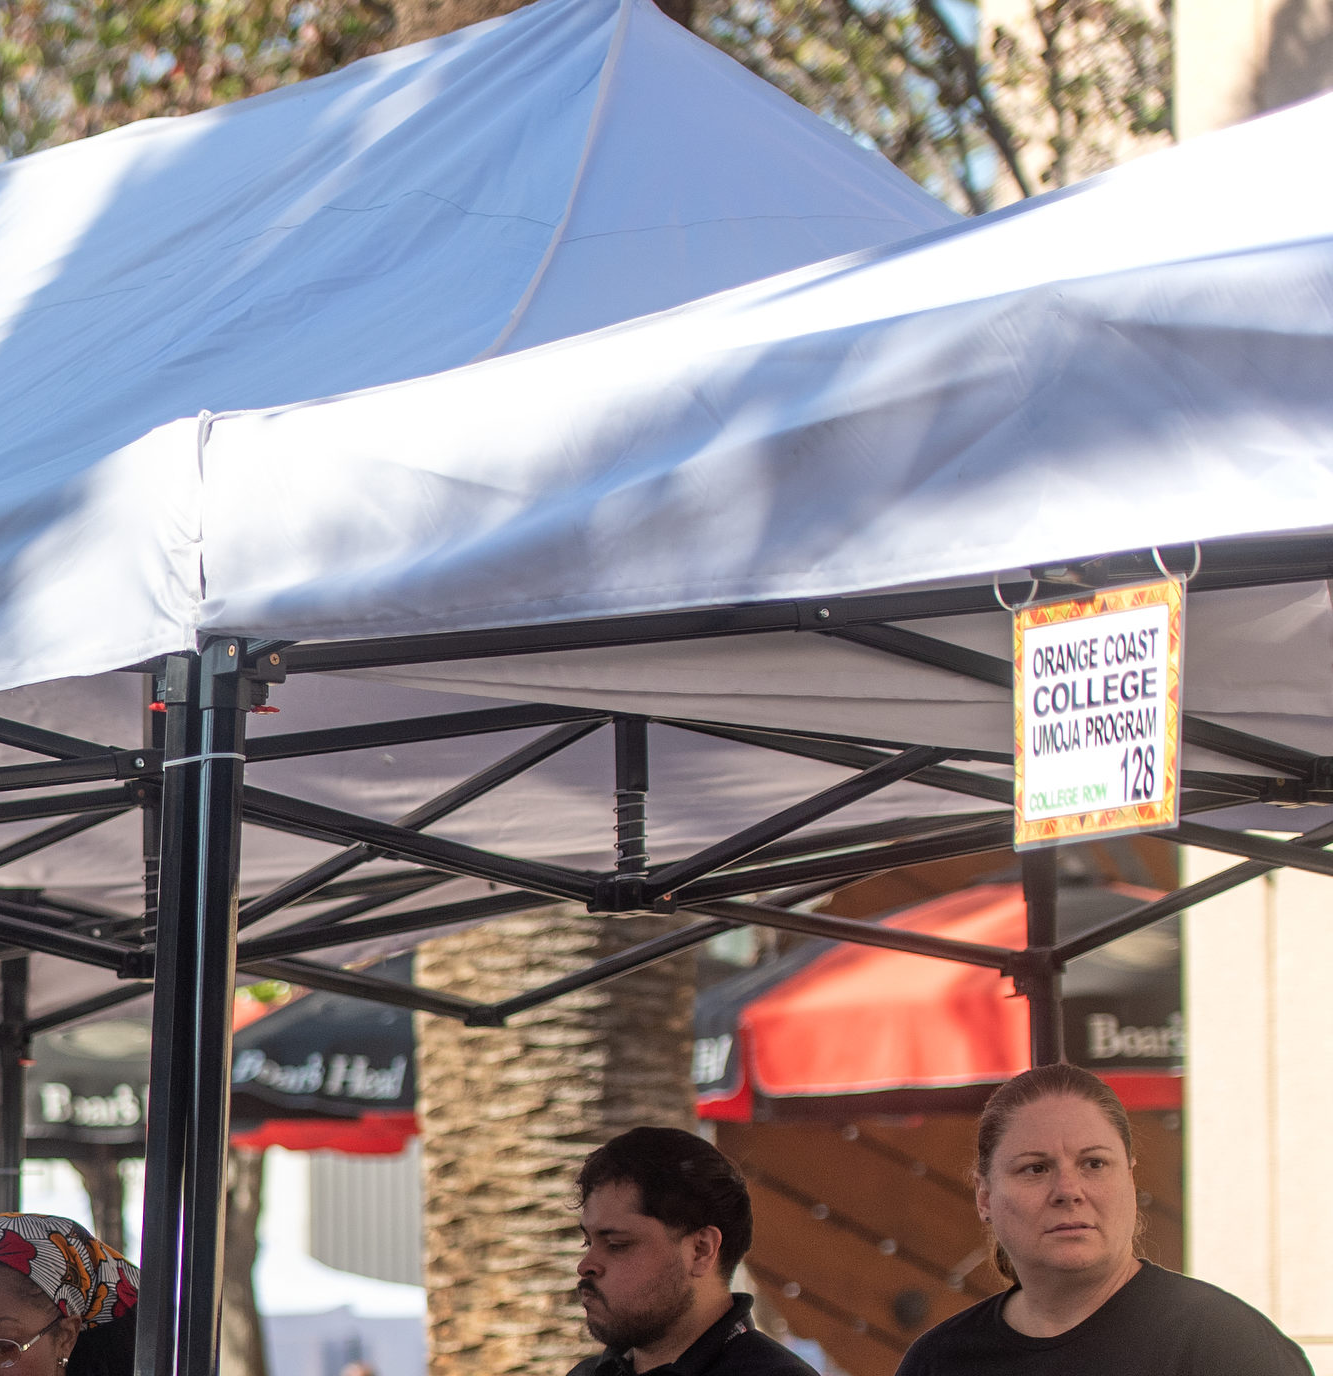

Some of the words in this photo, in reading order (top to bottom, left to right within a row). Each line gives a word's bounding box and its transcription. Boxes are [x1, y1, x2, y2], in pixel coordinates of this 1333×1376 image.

[1033, 638, 1099, 679] ORANGE
[1104, 628, 1159, 666] COAST
[1033, 667, 1158, 717] COLLEGE
[1033, 717, 1081, 756] UMOJA
[1086, 706, 1157, 748] PROGRAM
[1029, 788, 1078, 811] COLLEGE
[1083, 782, 1108, 803] ROW
[1121, 745, 1155, 802] 128
